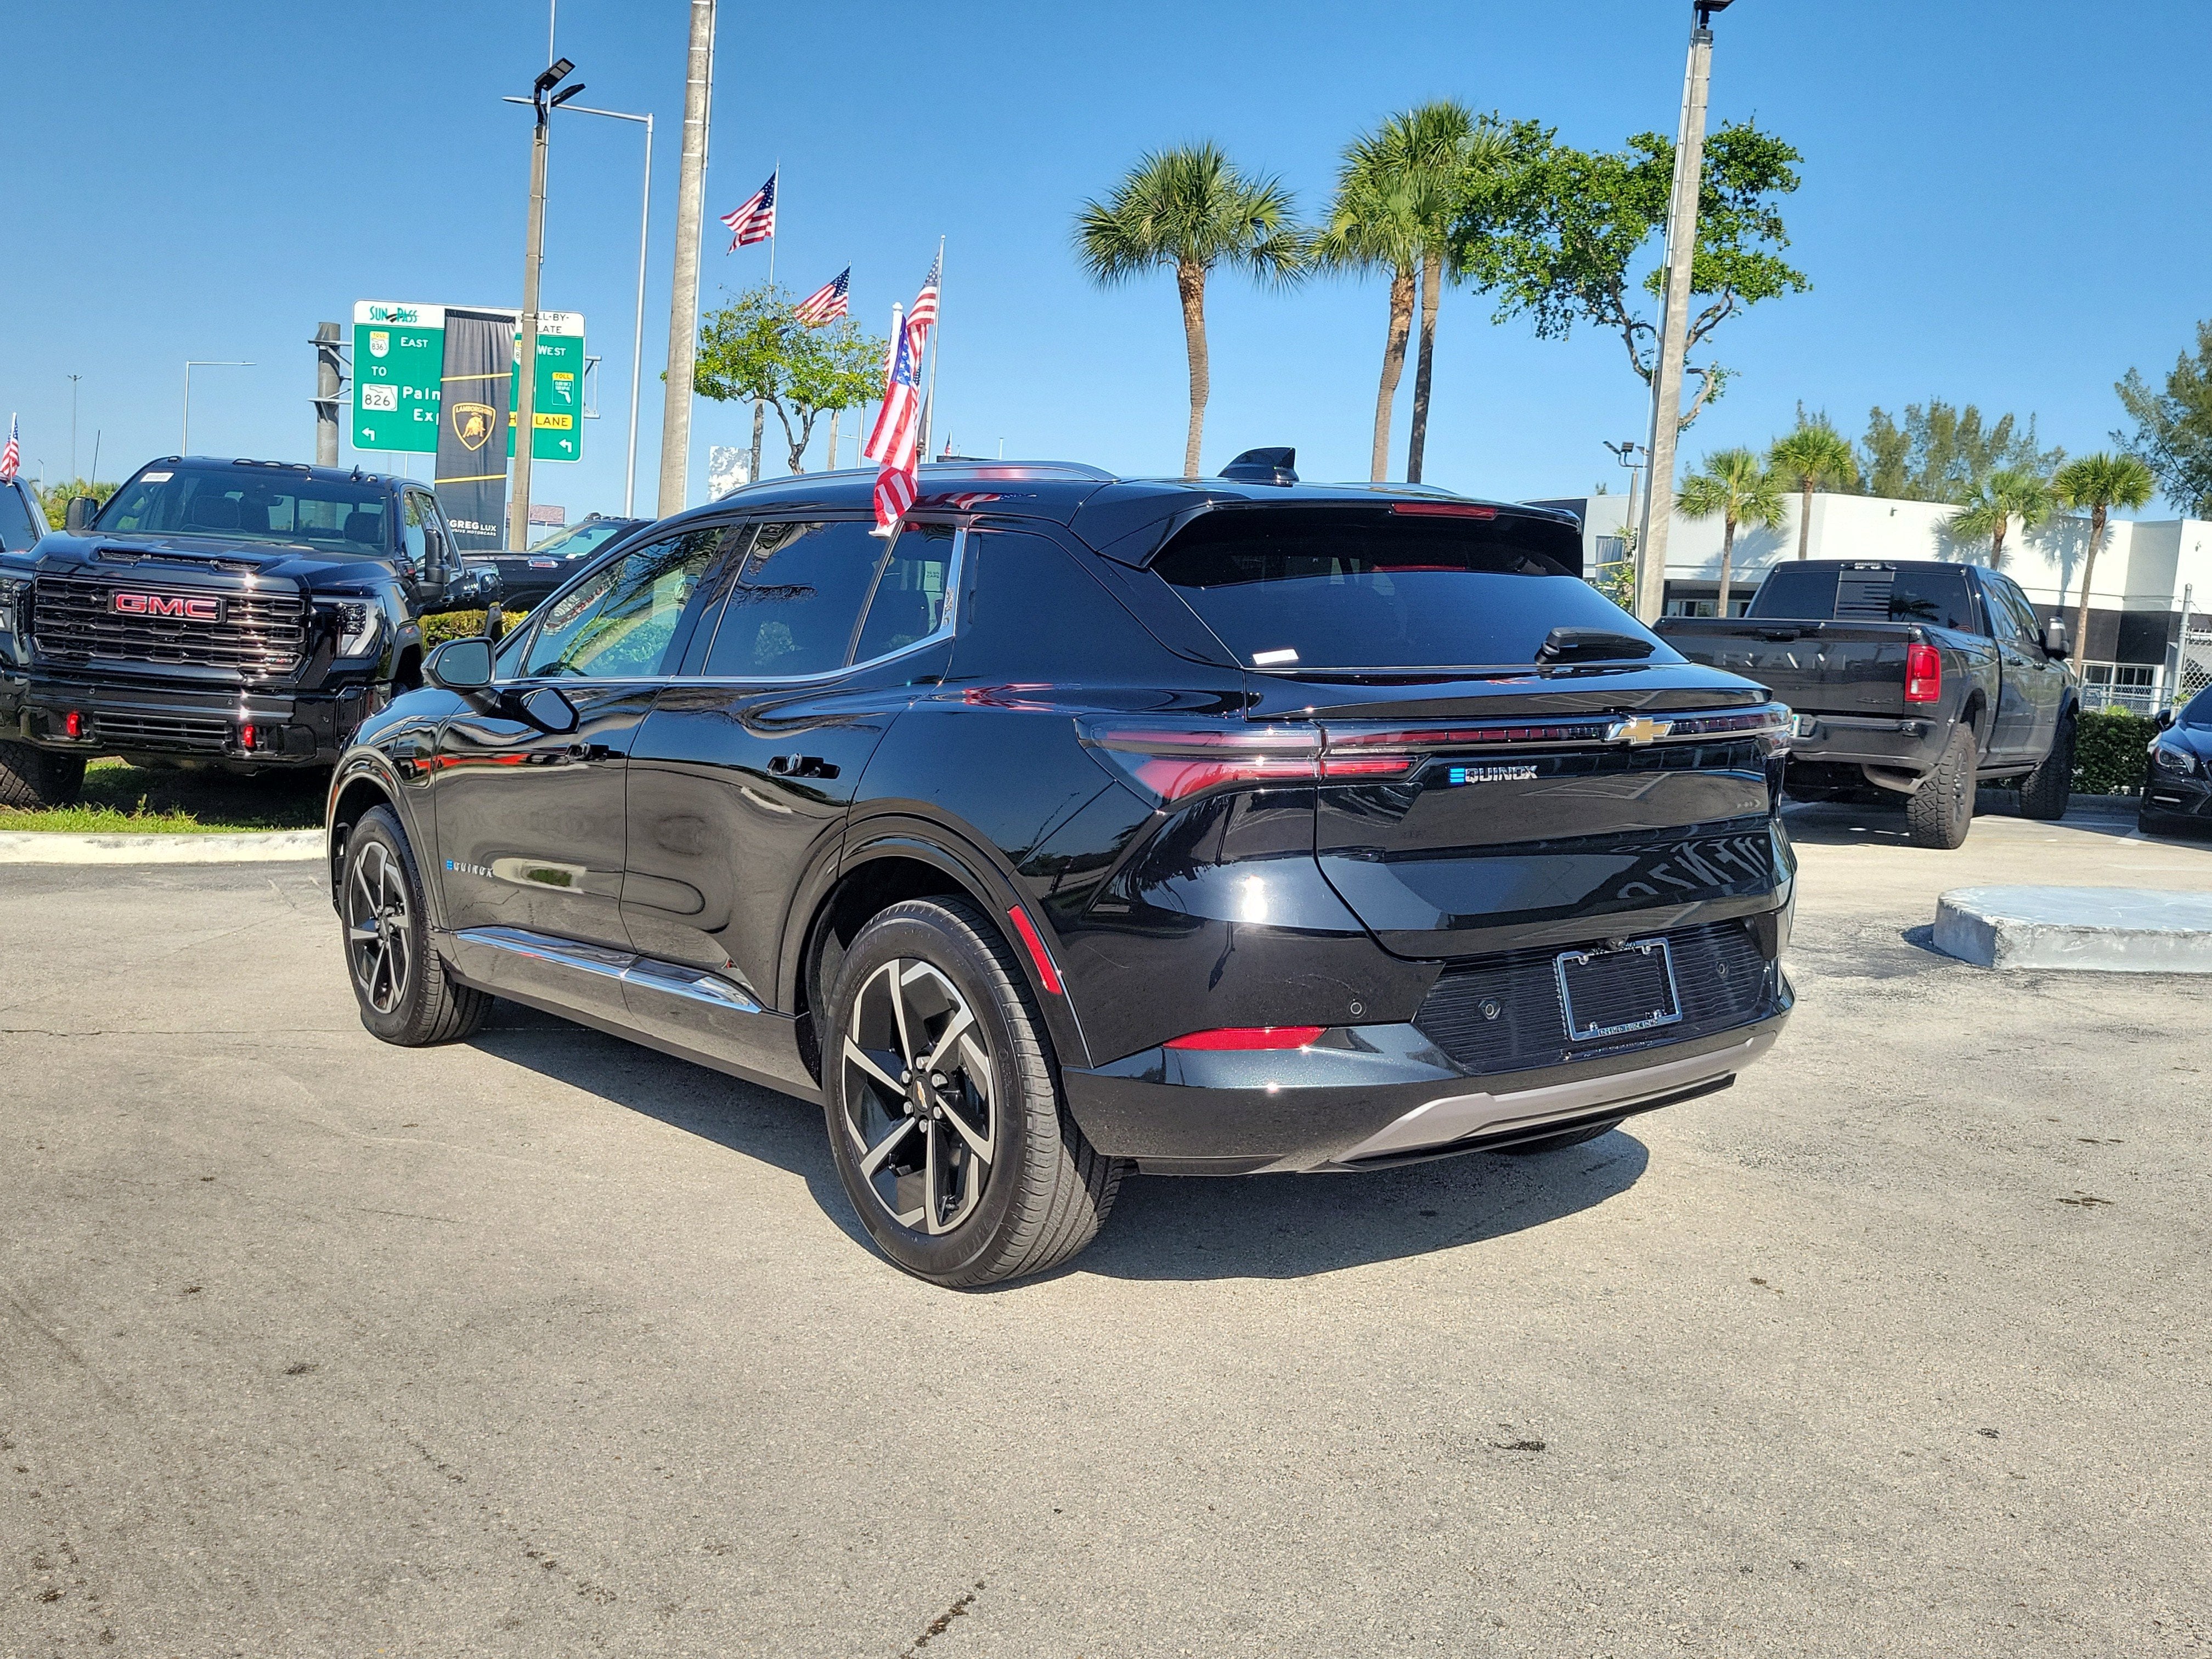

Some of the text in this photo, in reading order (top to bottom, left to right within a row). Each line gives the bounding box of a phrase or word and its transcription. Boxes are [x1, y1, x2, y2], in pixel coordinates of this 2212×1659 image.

[370, 306, 417, 323] SUN PASS
[400, 337, 428, 348] EAST
[538, 345, 567, 357] WEST
[371, 366, 387, 377] TO
[365, 394, 391, 407] 826
[535, 416, 568, 427] LANE
[116, 594, 218, 620] GMC
[1714, 651, 1847, 670] RAM
[1449, 765, 1538, 784] EQUINOX
[446, 860, 494, 878] EQUINOX
